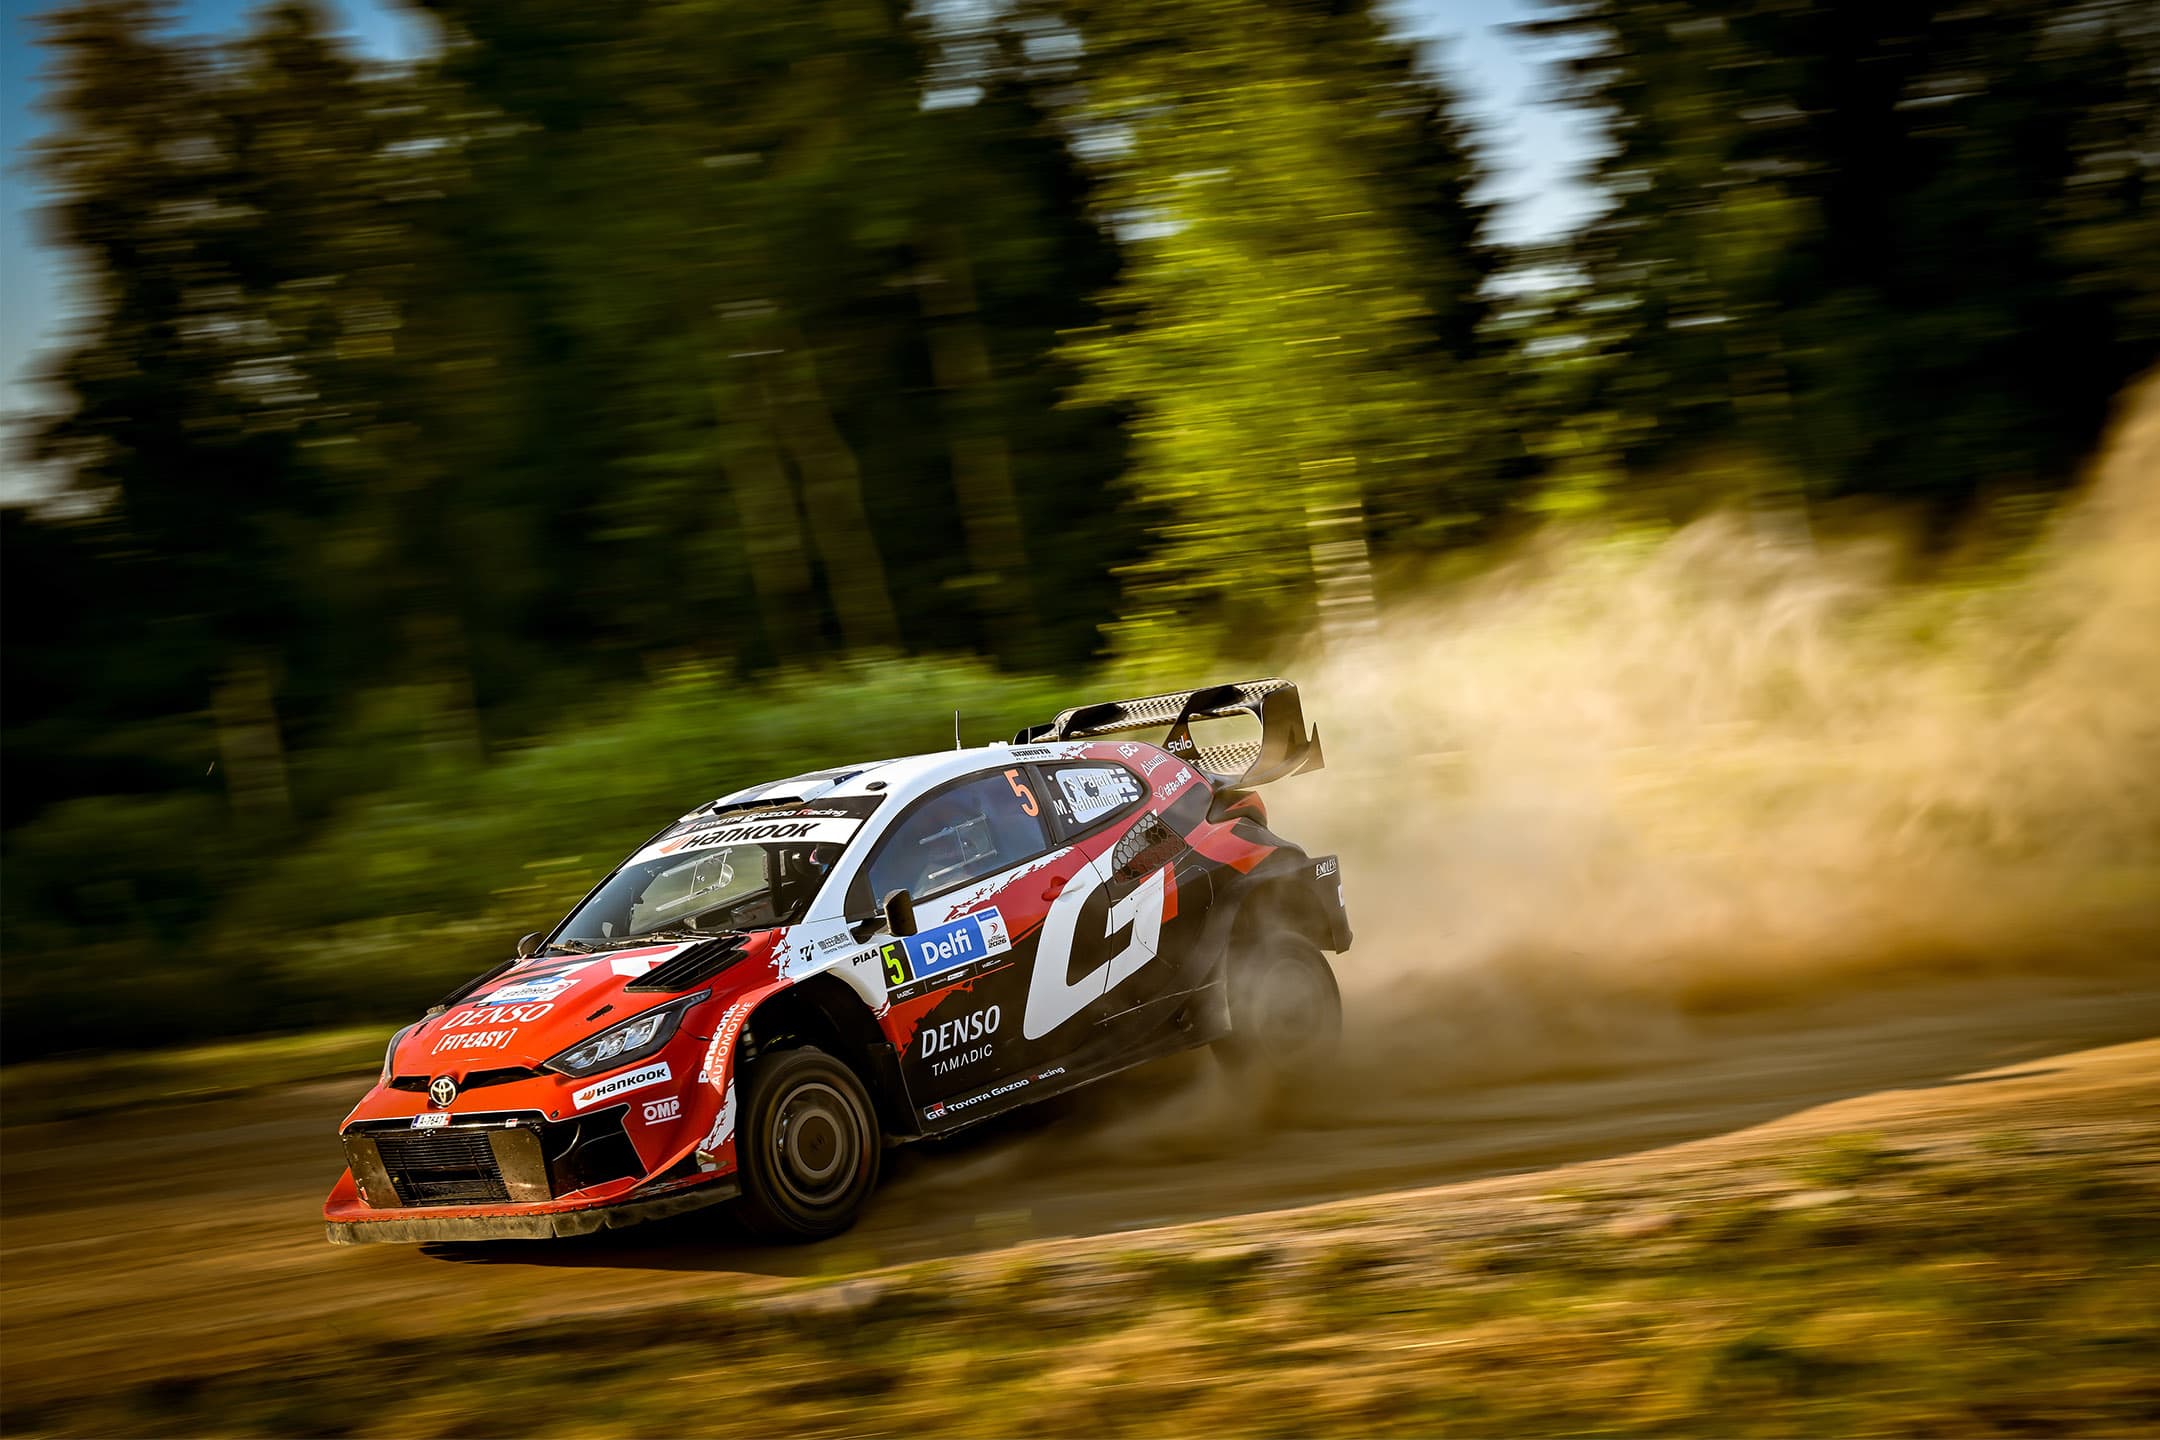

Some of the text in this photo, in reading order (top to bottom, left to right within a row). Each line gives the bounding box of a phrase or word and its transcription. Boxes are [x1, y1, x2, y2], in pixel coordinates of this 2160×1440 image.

[1167, 735, 1193, 754] Stilo
[795, 808, 849, 818] Racing
[1003, 769, 1040, 817] 5
[851, 948, 879, 967] PIAA
[880, 943, 906, 986] 5
[920, 927, 973, 967] Delfi
[439, 1003, 555, 1031] DENSO
[920, 1004, 1001, 1060] DENSO
[698, 1003, 740, 1084] Panasonic
[710, 1001, 754, 1086] AUTOMOTIVE
[931, 1043, 994, 1077] TAMADIC
[643, 1099, 681, 1121] OMP
[925, 1107, 947, 1121] GR
[946, 1092, 992, 1112] TOYOTA
[991, 1078, 1030, 1097] GAZOO
